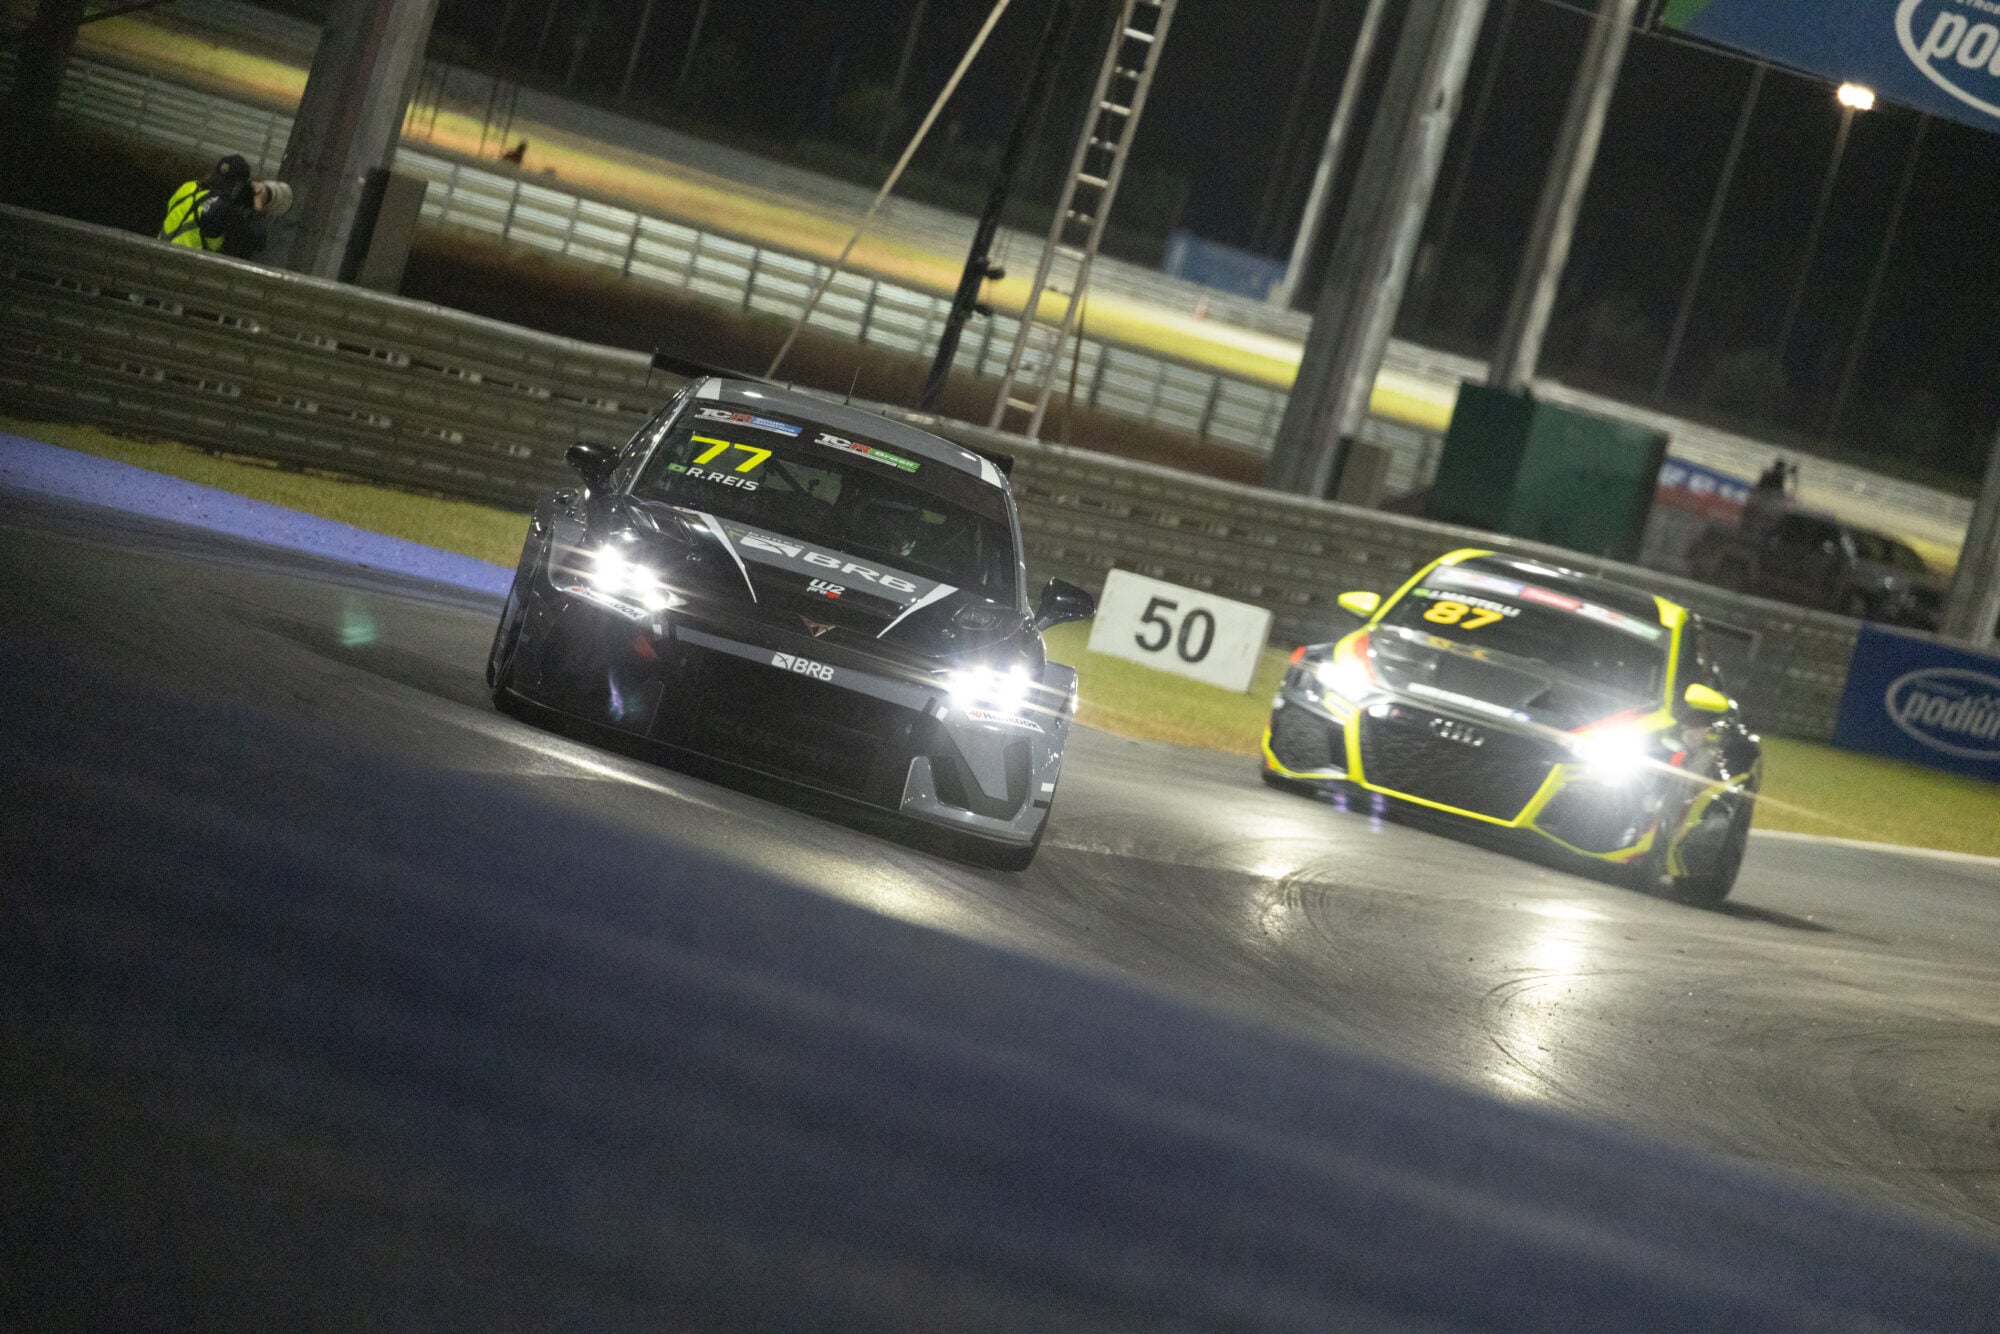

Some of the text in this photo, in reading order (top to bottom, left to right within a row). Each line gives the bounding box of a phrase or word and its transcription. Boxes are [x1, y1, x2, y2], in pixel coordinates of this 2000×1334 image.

[691, 435, 772, 473] 77
[685, 467, 760, 492] R.REIS
[803, 551, 919, 594] BRB
[1134, 597, 1216, 664] 50
[1423, 600, 1503, 629] 87
[792, 657, 834, 682] BRB
